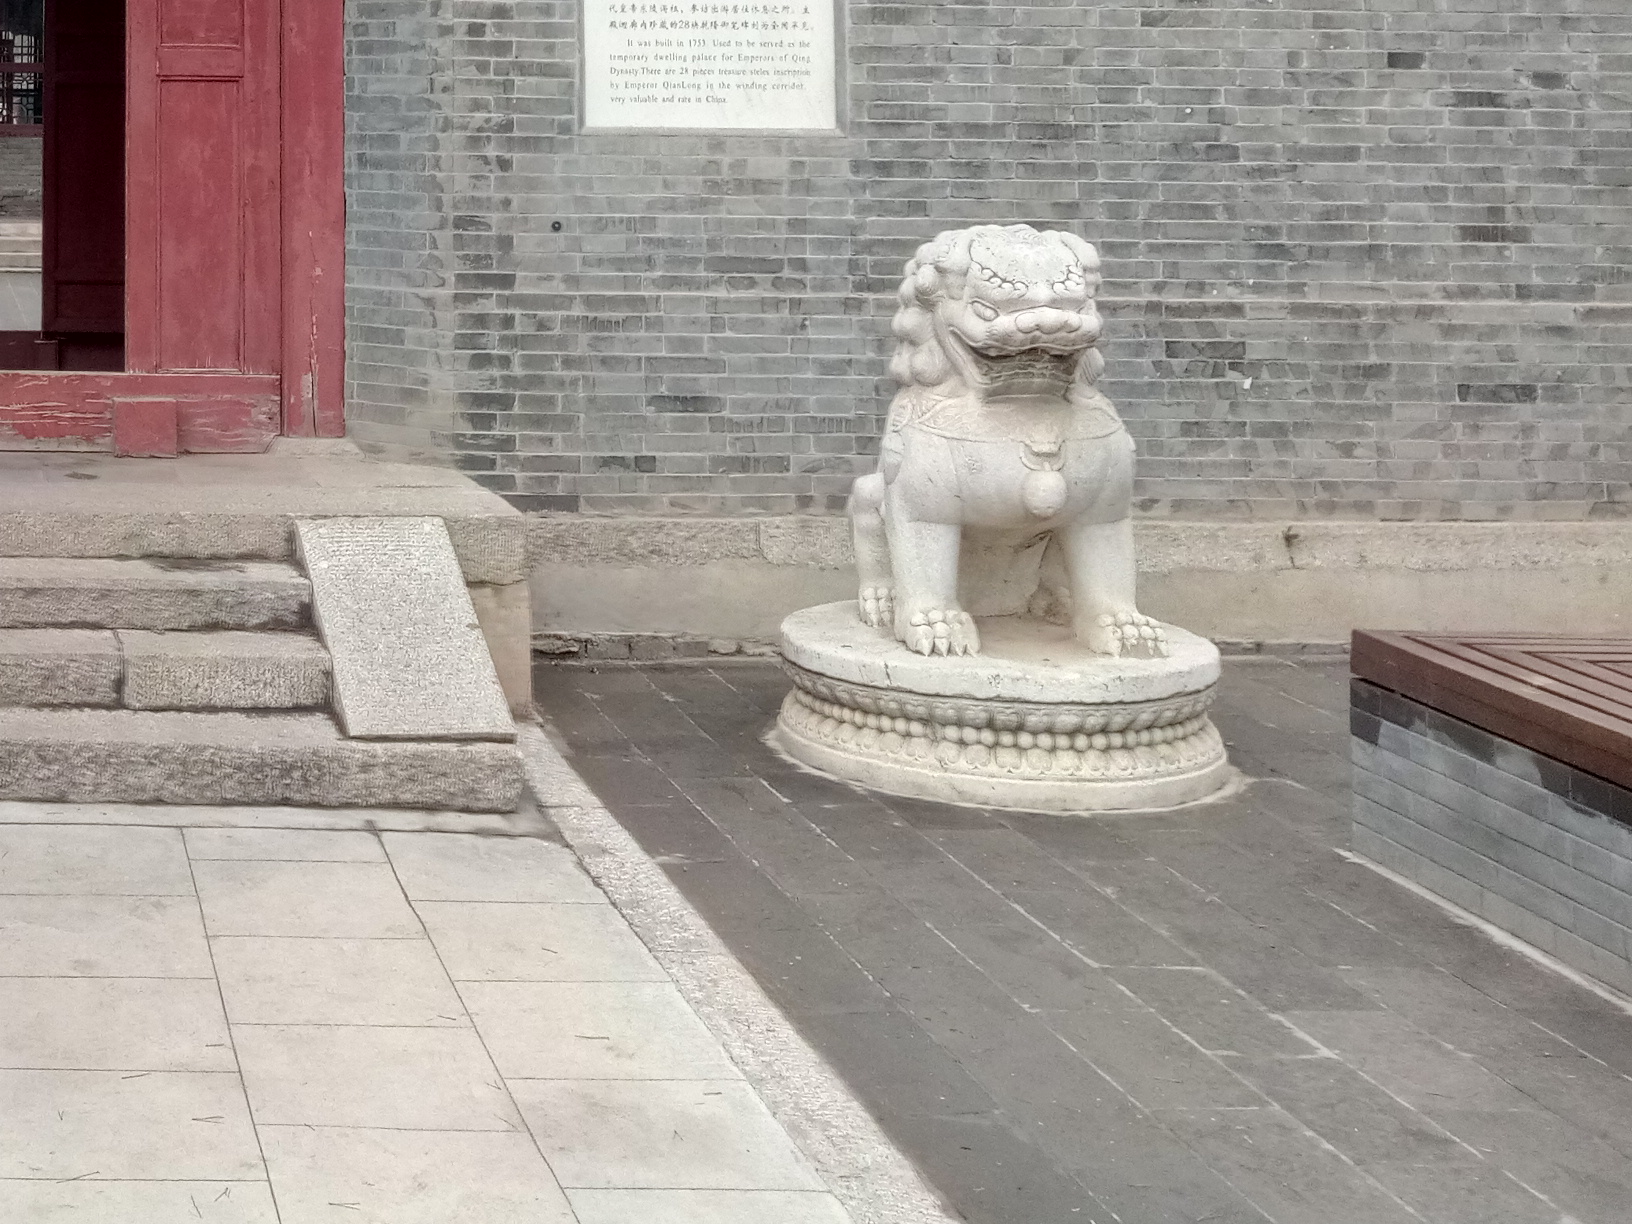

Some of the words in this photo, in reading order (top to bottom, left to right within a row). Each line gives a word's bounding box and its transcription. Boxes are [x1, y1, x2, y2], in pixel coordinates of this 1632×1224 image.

[637, 39, 651, 47] was
[655, 38, 672, 47] built
[676, 39, 684, 47] in
[712, 39, 731, 47] Used
[735, 39, 743, 47] to
[746, 39, 755, 48] be
[759, 40, 783, 48] served
[799, 40, 810, 48] the
[609, 53, 649, 62] temporary
[653, 53, 687, 62] dwelling
[691, 53, 717, 62] palace
[721, 53, 733, 61] for
[737, 53, 774, 63] Emperors
[779, 54, 788, 62] of
[791, 54, 811, 63] Qing
[679, 67, 689, 75] 28
[692, 68, 714, 76] pieces
[773, 68, 811, 77] inscription
[610, 80, 619, 90] by
[624, 80, 658, 90] Emperor
[662, 80, 701, 91] QianLong
[706, 80, 714, 89] in
[718, 81, 730, 89] the
[735, 81, 767, 92] winding
[610, 95, 625, 105] very
[629, 94, 658, 103] valuable
[662, 95, 674, 103] and
[678, 95, 691, 103] rare
[695, 95, 702, 103] in
